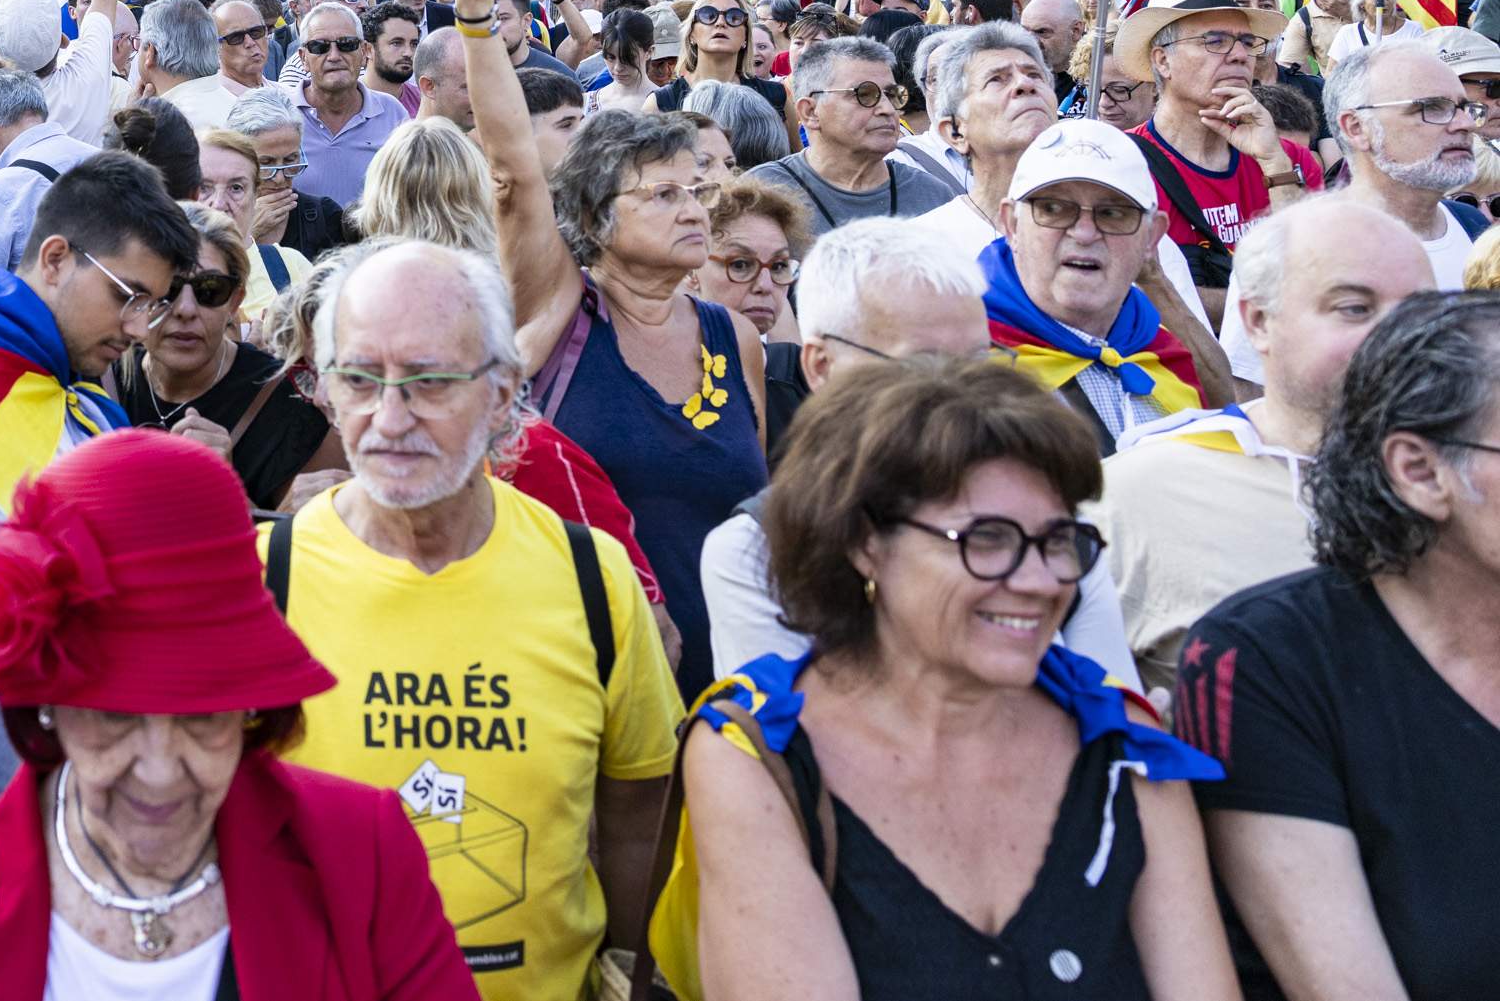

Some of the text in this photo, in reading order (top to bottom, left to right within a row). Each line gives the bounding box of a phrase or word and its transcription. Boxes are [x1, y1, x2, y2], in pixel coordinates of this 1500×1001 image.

[364, 661, 511, 709] ARA ÉS
[364, 711, 527, 752] L'HORA!
